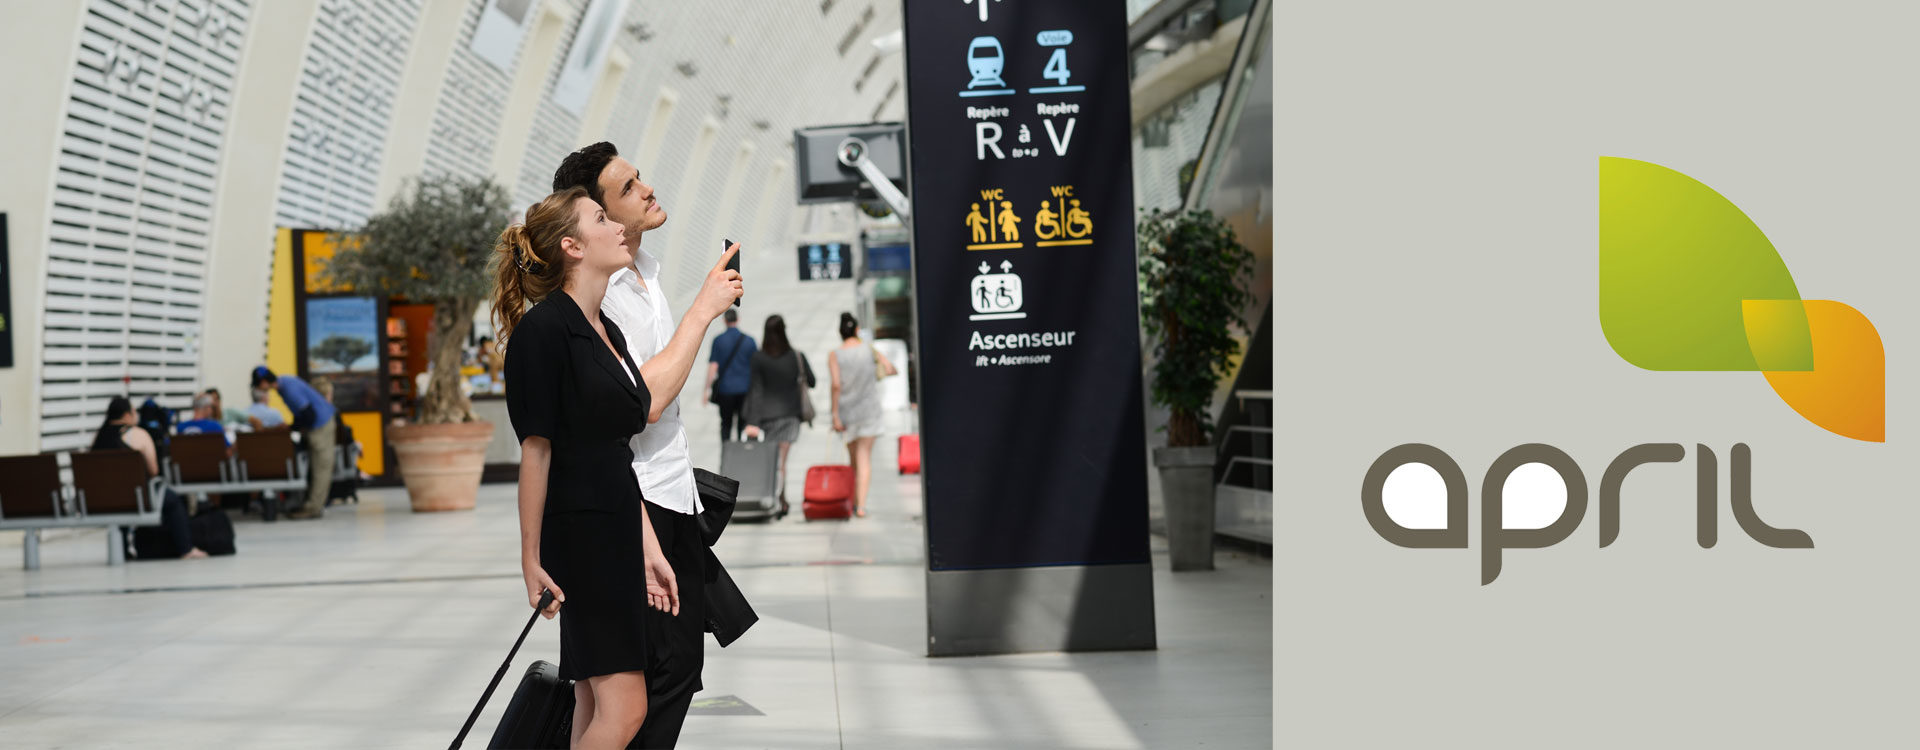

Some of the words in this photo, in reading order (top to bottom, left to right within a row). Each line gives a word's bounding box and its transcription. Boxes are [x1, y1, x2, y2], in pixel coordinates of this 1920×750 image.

[1041, 33, 1068, 43] Voie
[1043, 48, 1071, 86] 4
[967, 106, 1009, 120] Repère
[1037, 102, 1080, 117] Repère
[976, 121, 1006, 160] R
[1018, 123, 1031, 143] à
[1043, 117, 1076, 157] V
[980, 188, 1004, 201] WC
[1050, 185, 1074, 198] WC
[968, 330, 1076, 351] Ascenseur
[998, 354, 1051, 366] Ascensore
